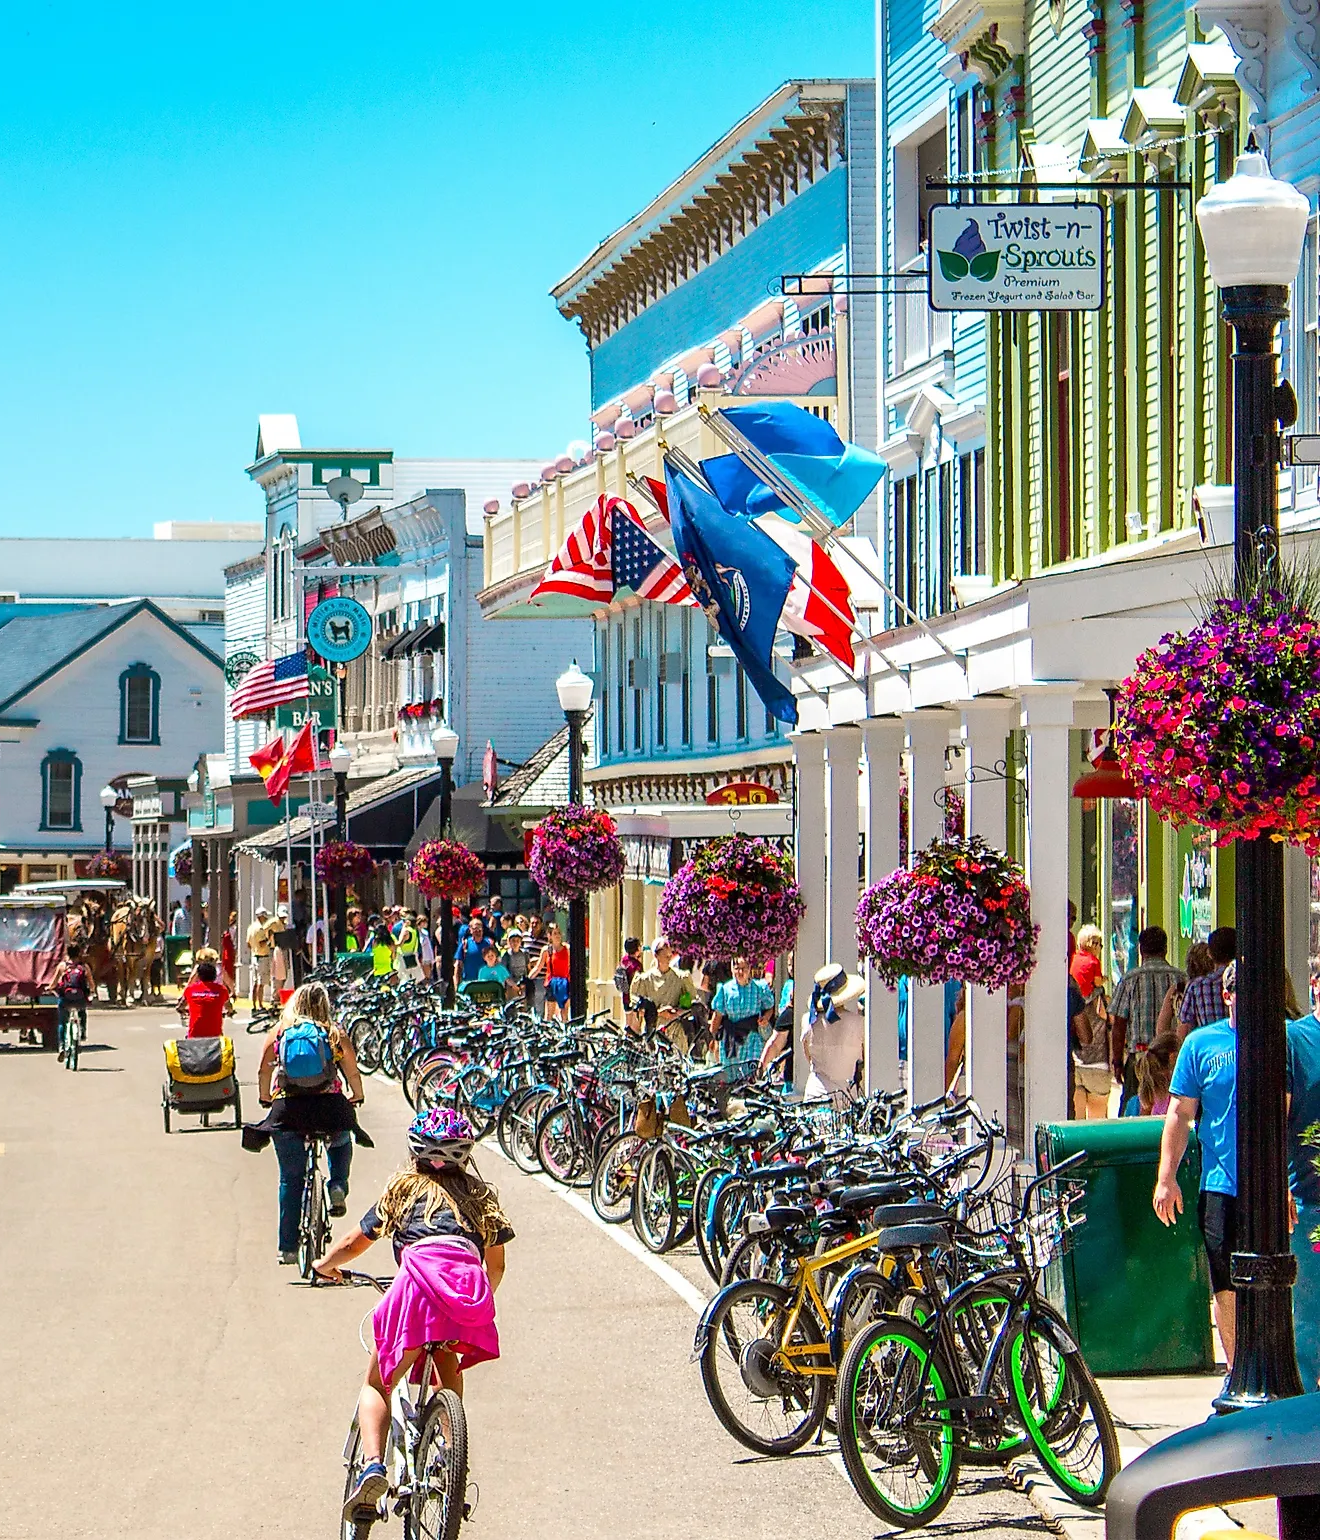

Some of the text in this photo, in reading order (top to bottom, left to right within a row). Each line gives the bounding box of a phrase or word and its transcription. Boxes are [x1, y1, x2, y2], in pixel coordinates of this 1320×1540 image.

[987, 212, 1051, 240] Twist
[1003, 275, 1060, 288] Premium
[951, 291, 986, 301] Frozen
[1025, 291, 1042, 301] and
[1044, 290, 1074, 301] Salad
[1076, 291, 1095, 301] Bar
[227, 652, 259, 671] STARBUC
[308, 681, 333, 696] N'S
[292, 711, 322, 727] BAR
